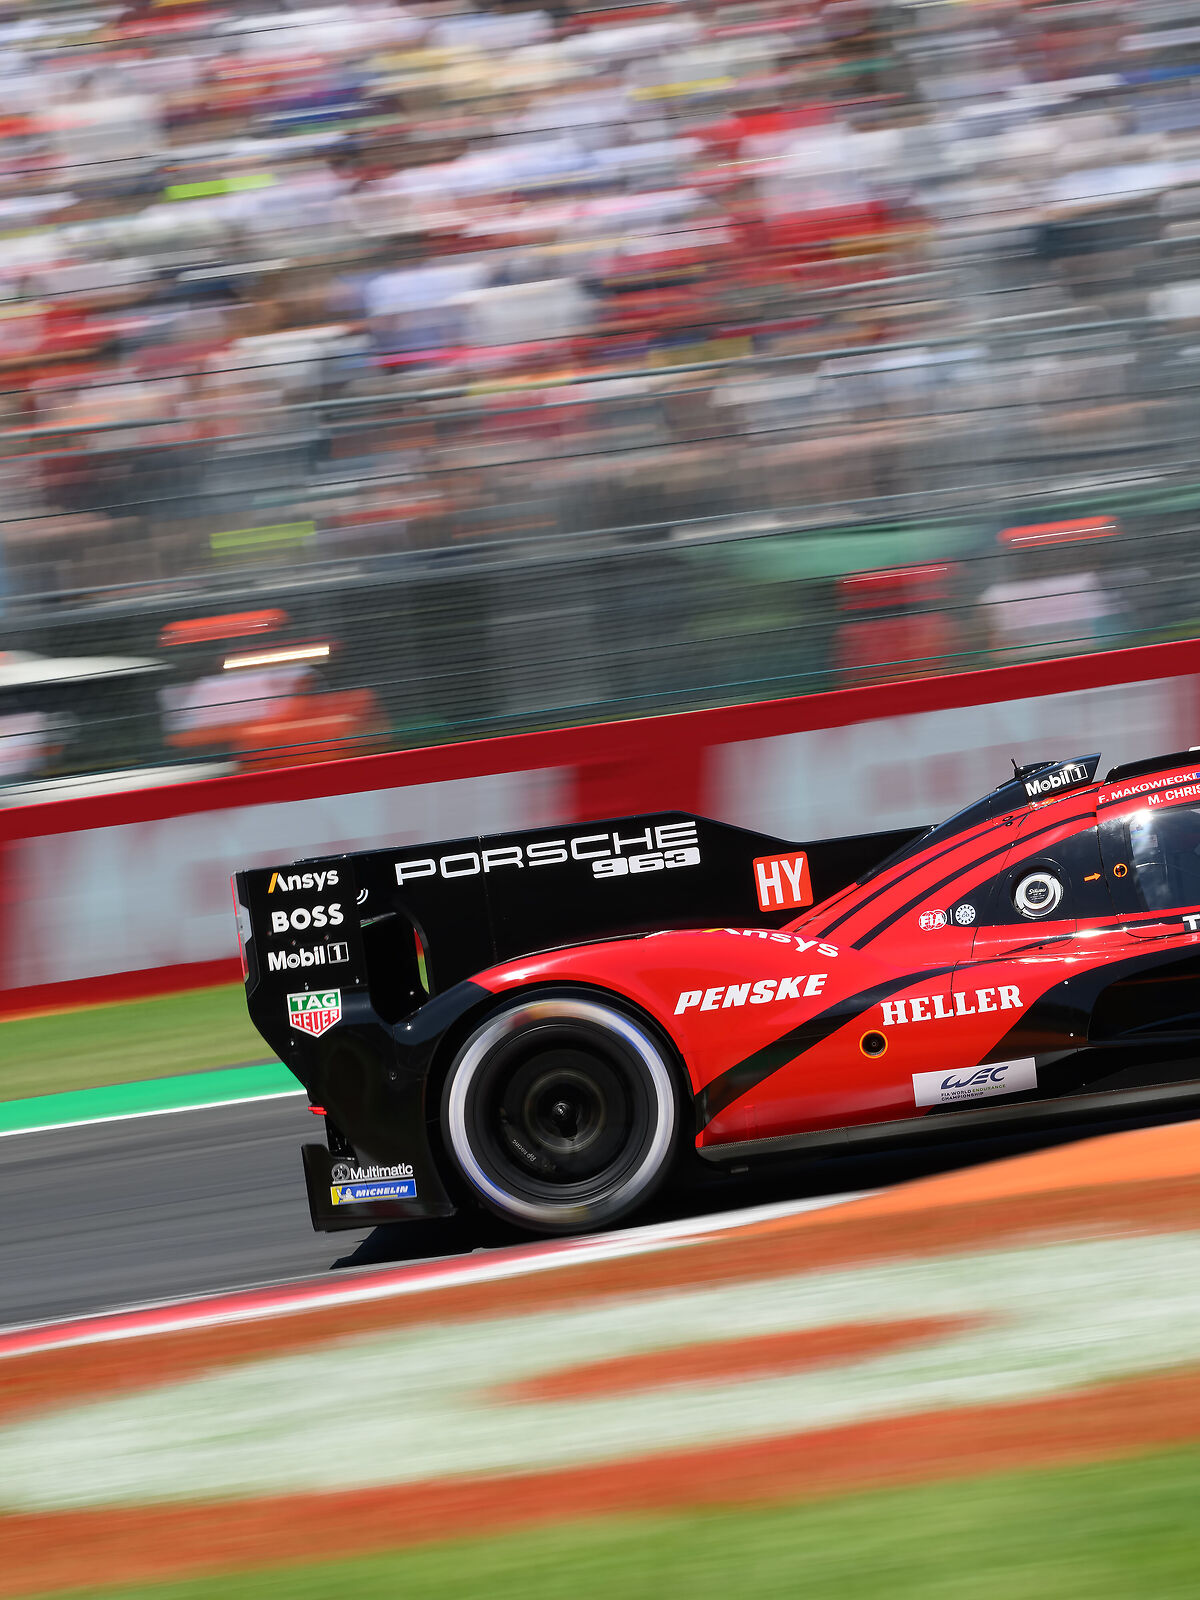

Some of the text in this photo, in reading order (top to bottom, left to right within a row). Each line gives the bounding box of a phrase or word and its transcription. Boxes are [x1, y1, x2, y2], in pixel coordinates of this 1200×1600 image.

[1111, 773, 1196, 800] MAKOWIECKI
[395, 821, 698, 886] PORSCHE
[592, 847, 701, 879] 963
[268, 870, 340, 894] Ansys
[757, 858, 804, 906] HY
[271, 903, 344, 933] BOSS
[920, 911, 946, 928] FIA
[292, 993, 337, 1011] TAG
[673, 973, 828, 1016] PENSKE
[880, 984, 1024, 1026] HELLER
[293, 1010, 338, 1033] HEUER
[941, 1065, 1009, 1090] WEC
[972, 1084, 1006, 1093] ENDURANCE
[350, 1163, 414, 1180] Multimatic
[355, 1185, 409, 1198] MICHELIN
